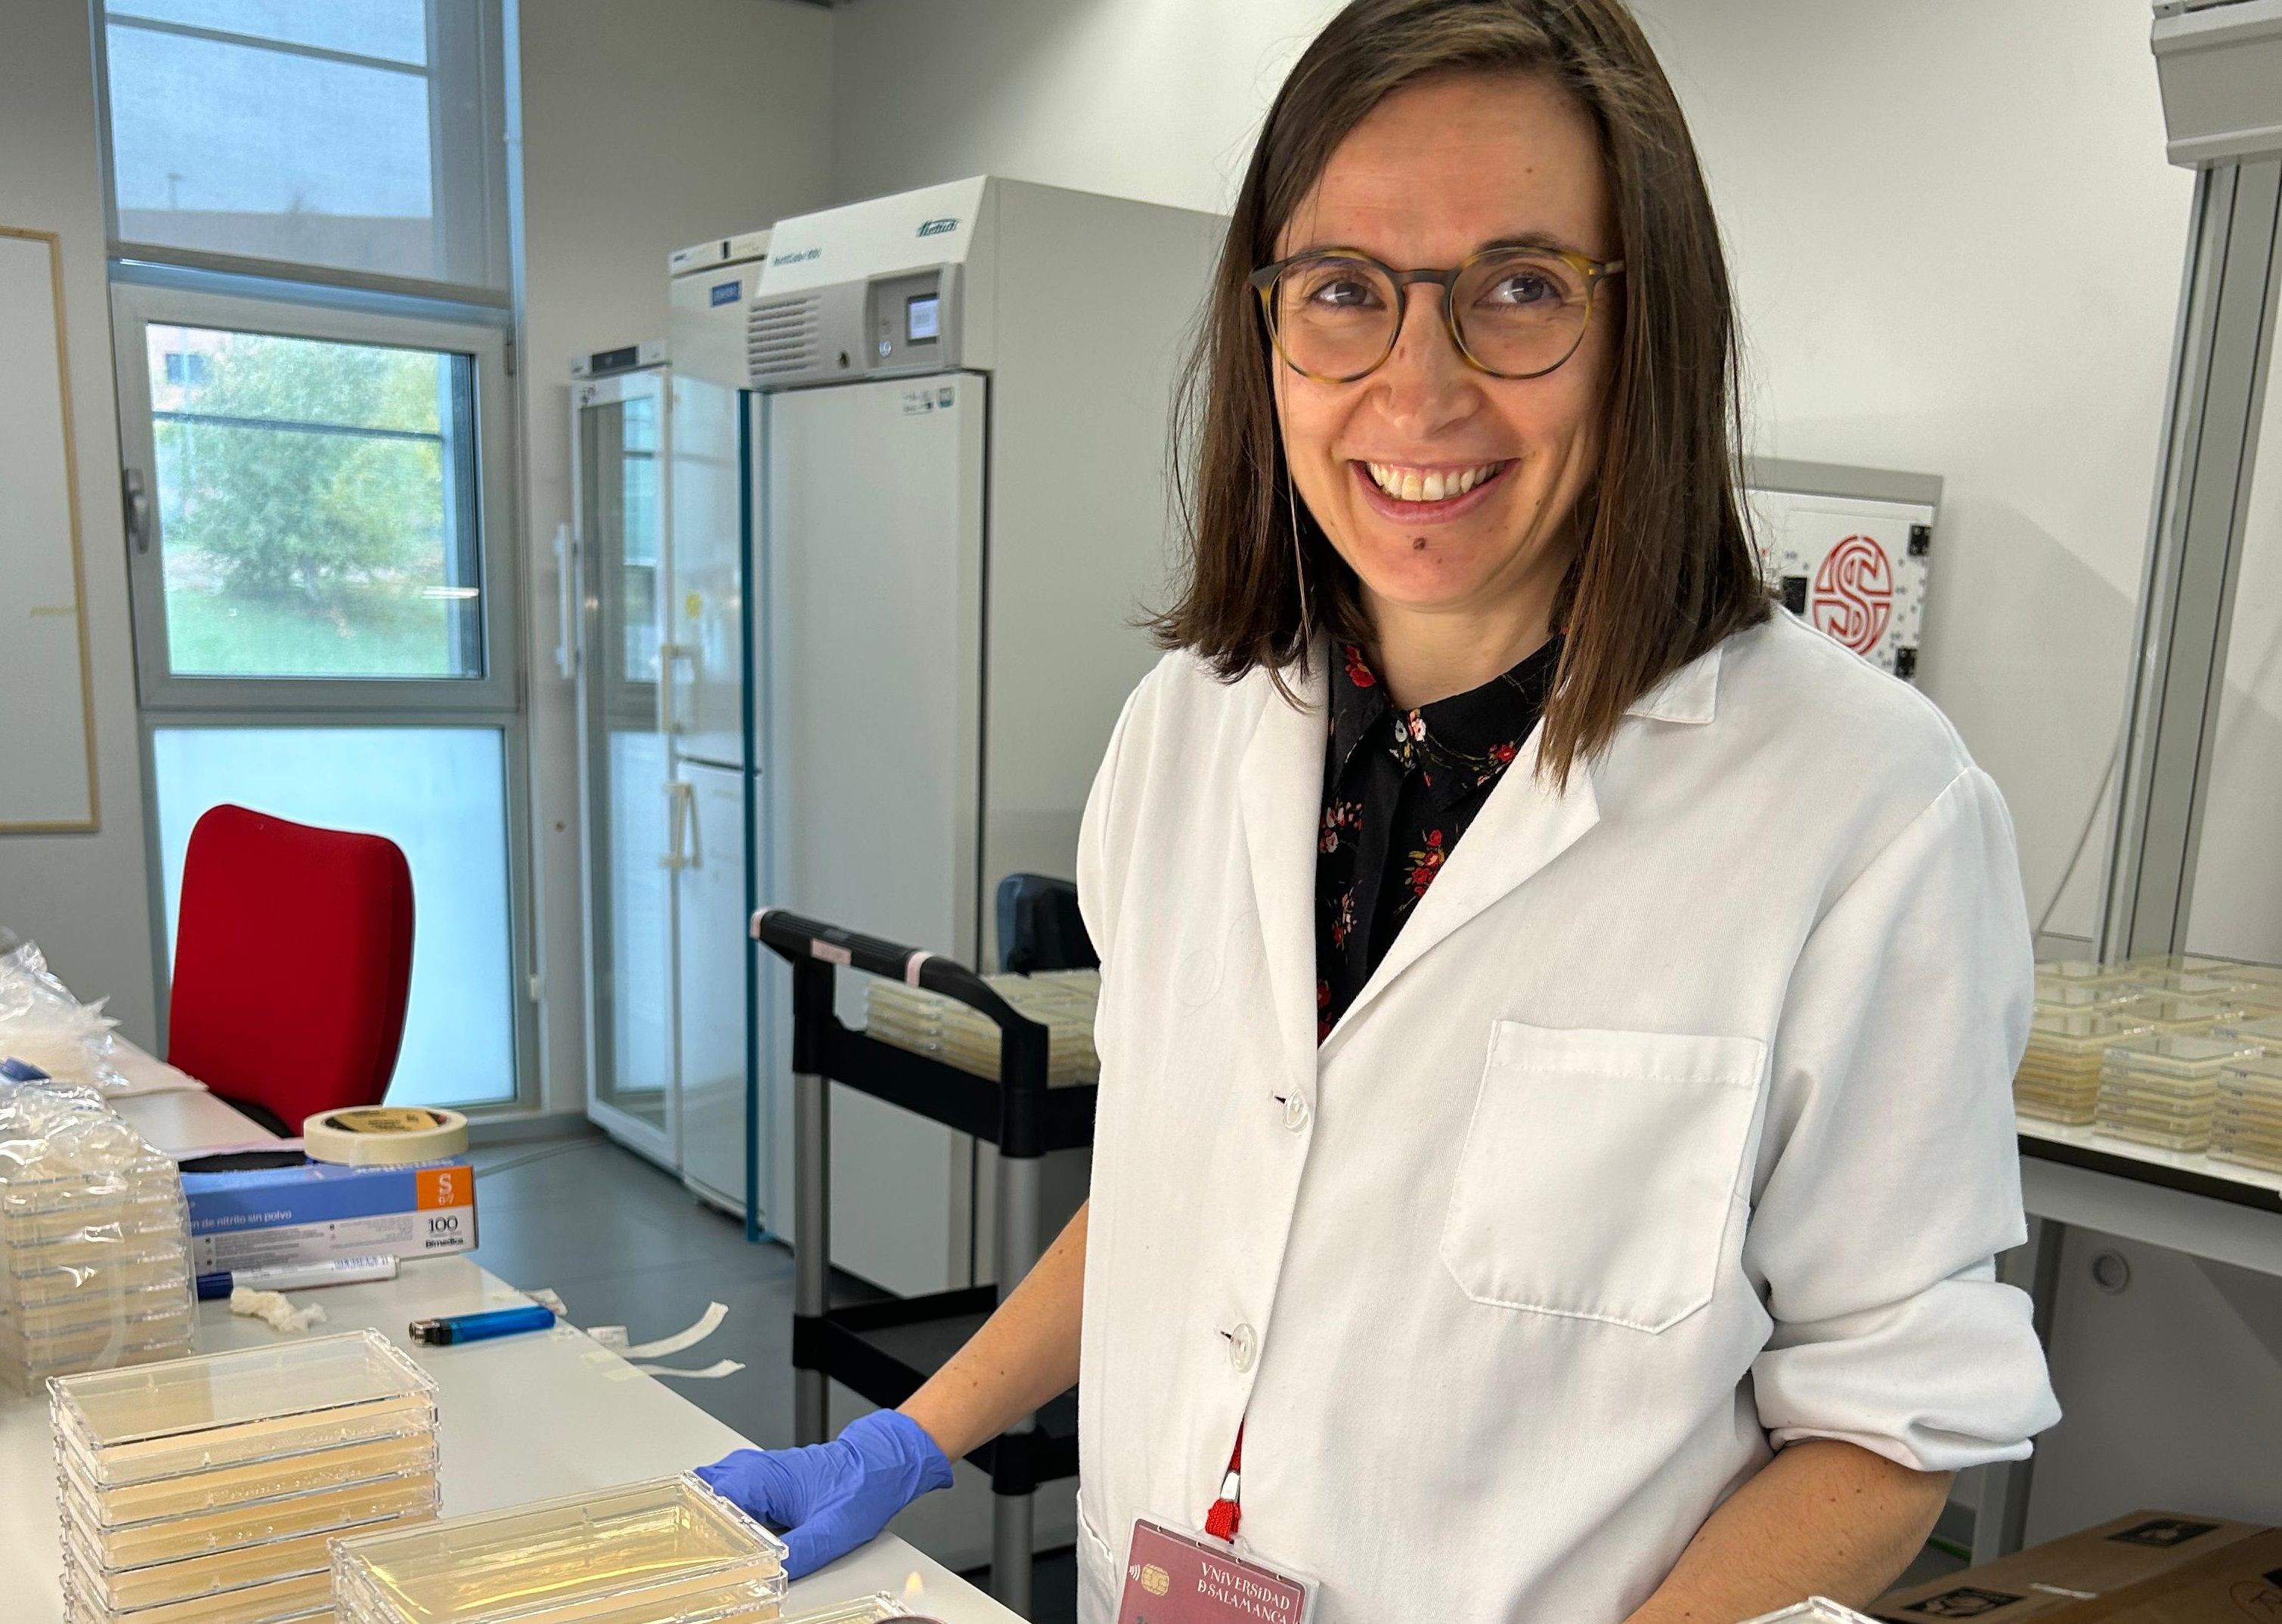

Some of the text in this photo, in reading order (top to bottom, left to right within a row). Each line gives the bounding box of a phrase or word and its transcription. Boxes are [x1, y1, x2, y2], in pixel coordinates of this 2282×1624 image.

[438, 1172, 453, 1194] S
[201, 1217, 215, 1228] de
[217, 1214, 247, 1227] nitrilo
[248, 1211, 262, 1223] sin
[264, 1209, 293, 1223] polvo
[428, 1215, 458, 1233] 100
